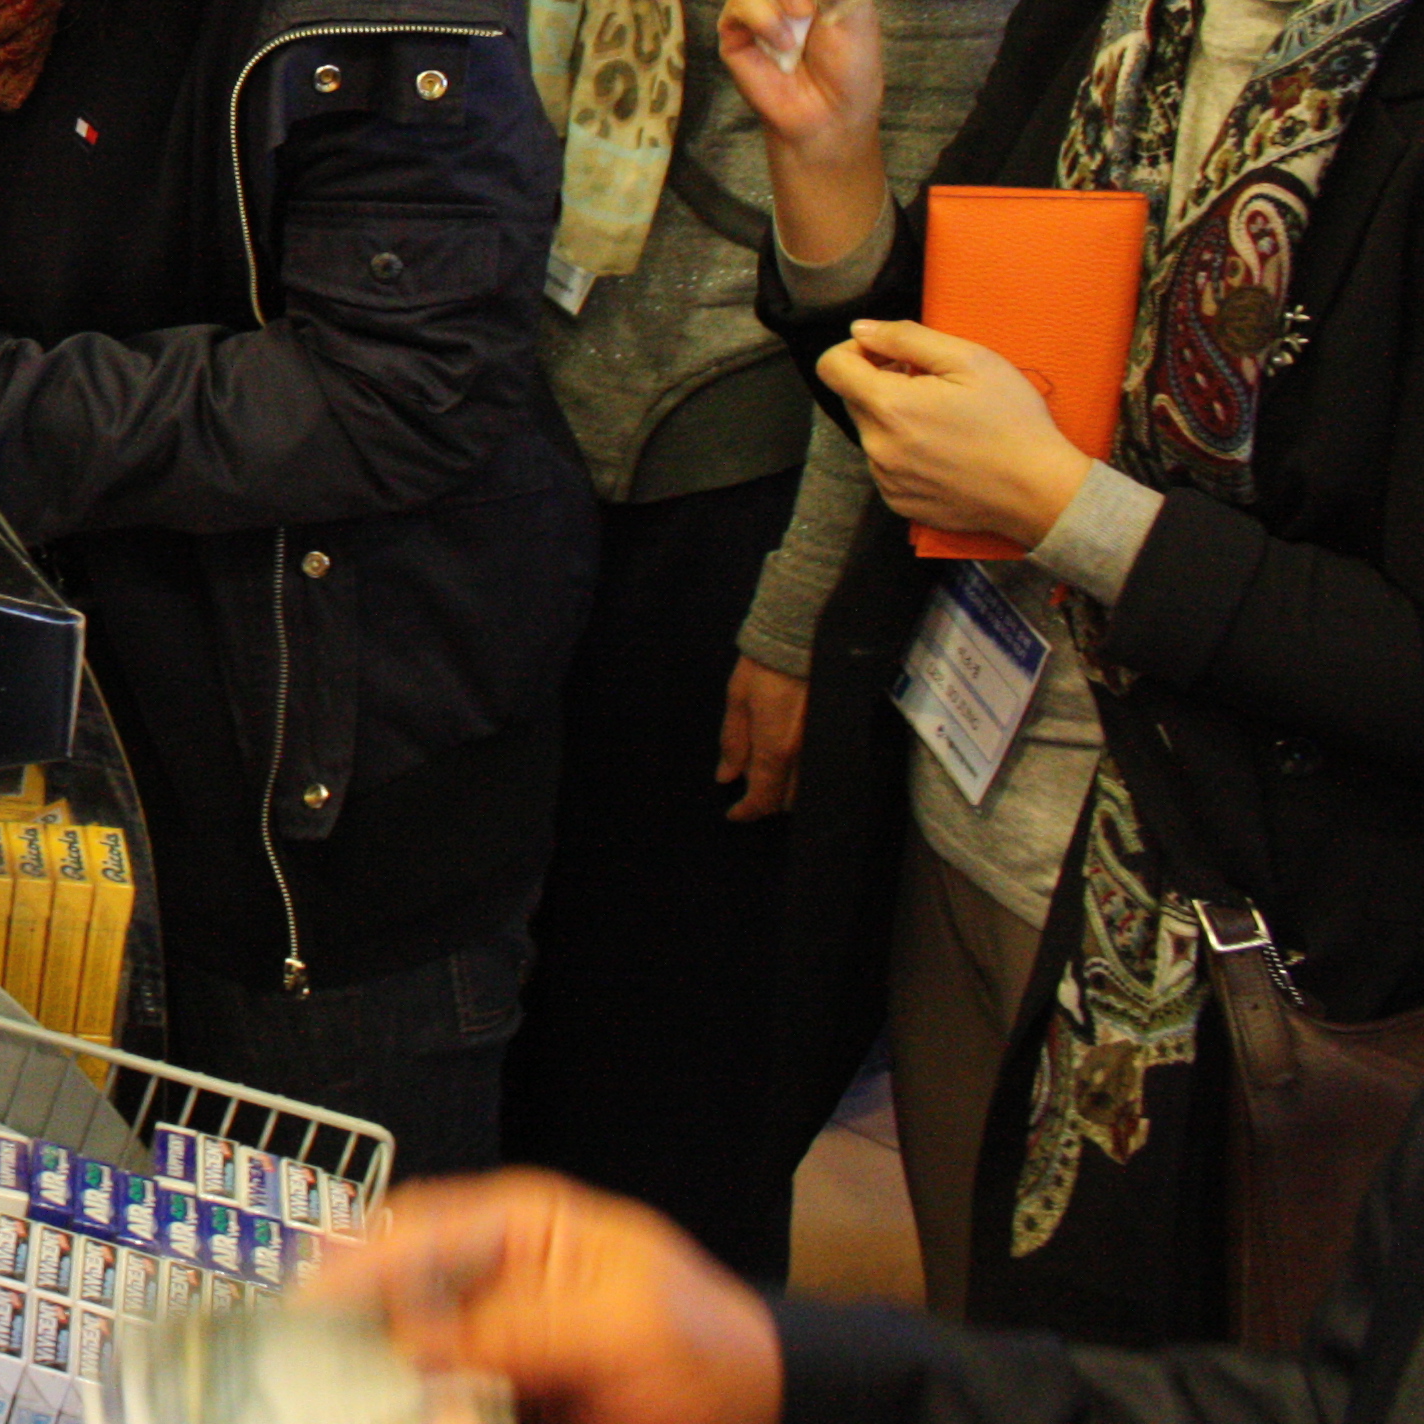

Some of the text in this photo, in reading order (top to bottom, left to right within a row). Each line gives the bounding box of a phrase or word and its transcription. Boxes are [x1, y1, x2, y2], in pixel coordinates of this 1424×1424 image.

[19, 827, 46, 877] Ricola
[58, 830, 87, 882] Ricola
[101, 831, 128, 884] Ricola
[39, 1170, 69, 1207] AIR
[82, 1187, 111, 1225] AIR
[126, 1203, 155, 1242] AIR
[169, 1221, 198, 1259] AIR
[212, 1233, 241, 1273] AIR
[254, 1244, 281, 1286] AIR
